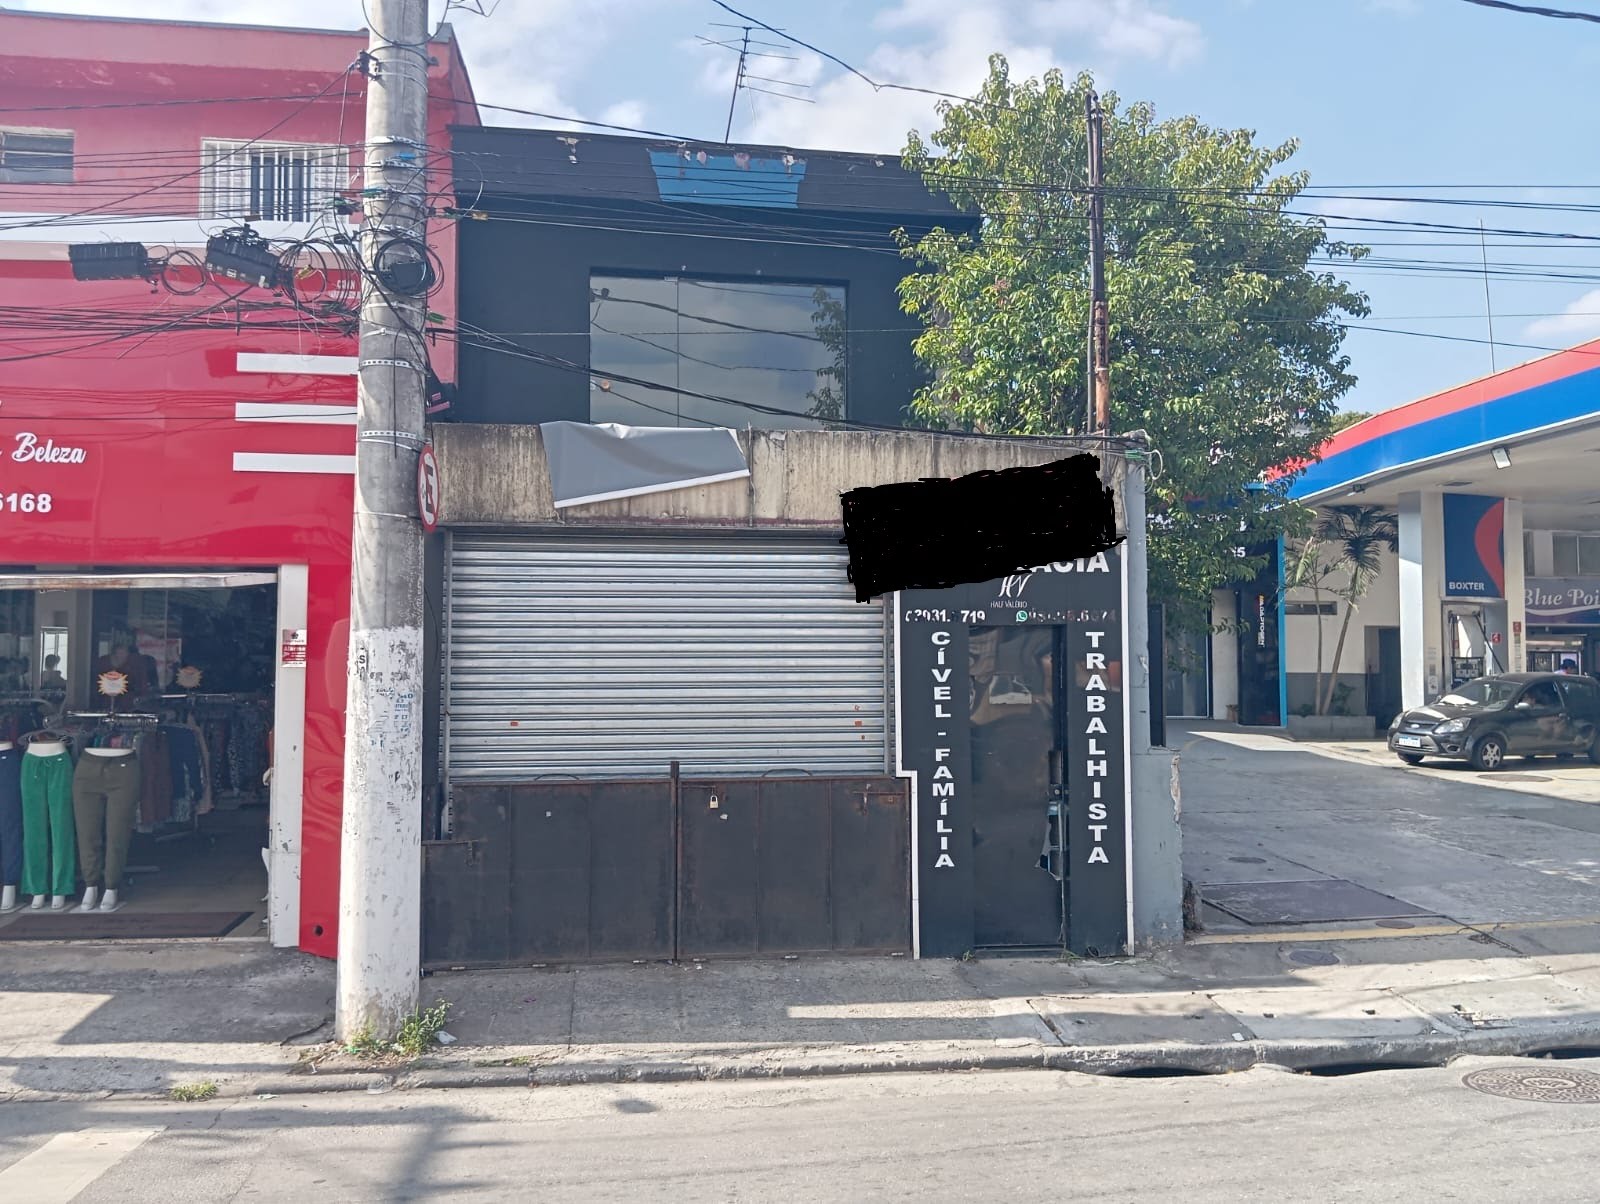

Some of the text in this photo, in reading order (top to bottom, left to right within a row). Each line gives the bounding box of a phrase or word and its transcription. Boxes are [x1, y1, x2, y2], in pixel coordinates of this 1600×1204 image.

[11, 432, 87, 464] Beleza
[0, 493, 52, 512] 168
[1449, 582, 1485, 591] BOXTER
[1524, 587, 1562, 606] Blue
[931, 631, 952, 718] CÍVEL
[1085, 631, 1110, 864] TRABALHISTA
[932, 748, 955, 868] FAMÍLIA
